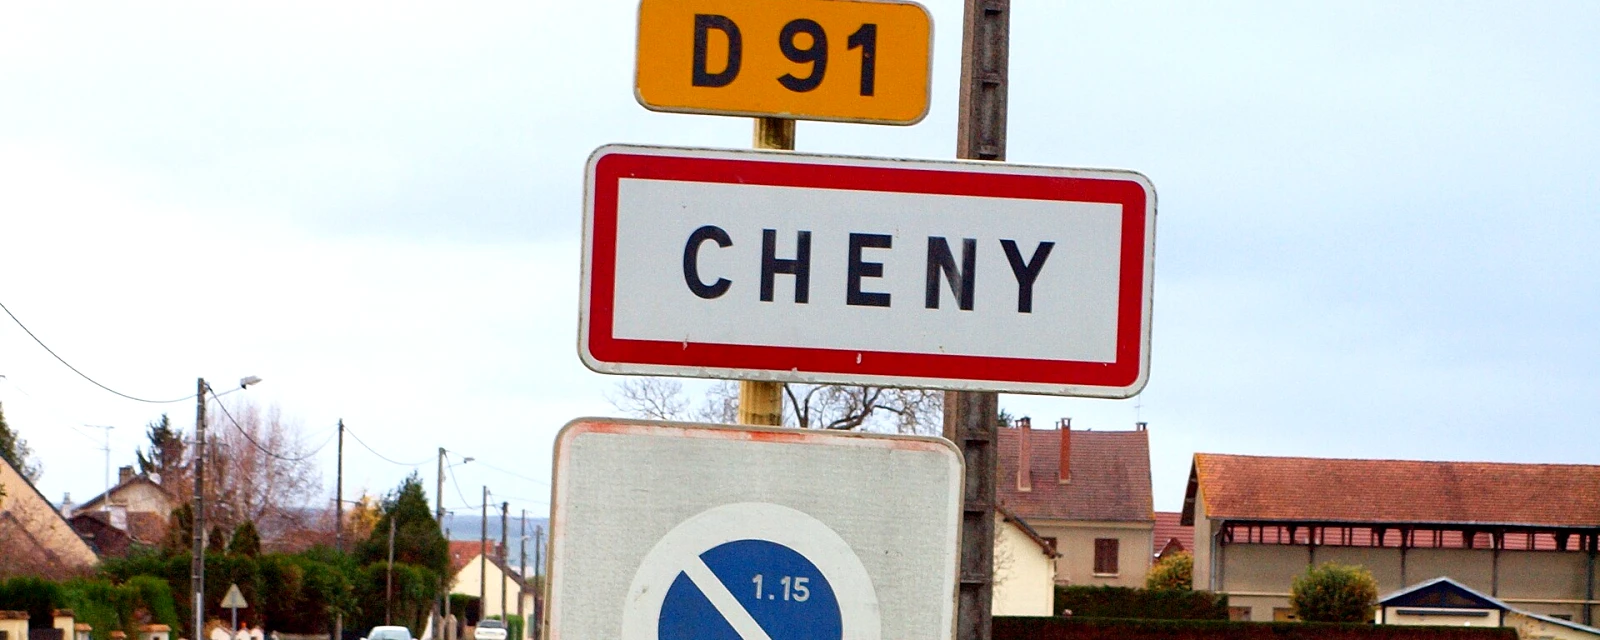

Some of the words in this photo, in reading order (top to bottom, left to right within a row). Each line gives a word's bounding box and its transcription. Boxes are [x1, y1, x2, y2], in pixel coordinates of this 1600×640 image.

[692, 14, 742, 87] D
[777, 18, 877, 97] 91
[683, 226, 1055, 313] CHENY
[752, 574, 810, 602] 1.15
